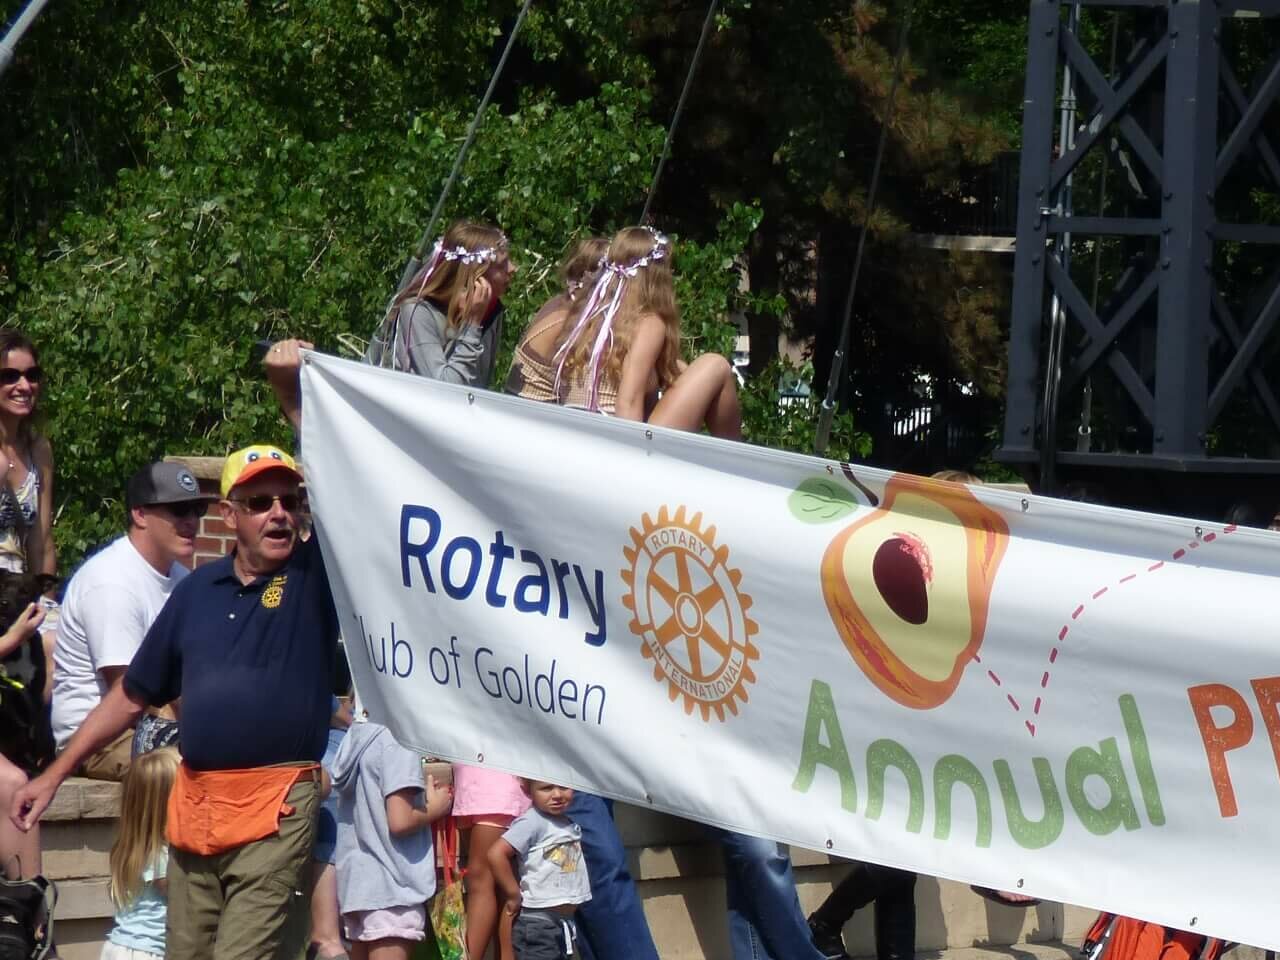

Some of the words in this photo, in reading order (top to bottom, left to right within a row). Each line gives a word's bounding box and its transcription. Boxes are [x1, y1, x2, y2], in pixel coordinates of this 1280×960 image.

[400, 504, 607, 647] Rotary
[651, 529, 706, 556] ROTARY
[353, 613, 413, 678] lub
[429, 636, 461, 688] of
[474, 647, 606, 724] Golden
[650, 640, 742, 699] INTERNATIONAL
[791, 679, 1166, 850] Annual
